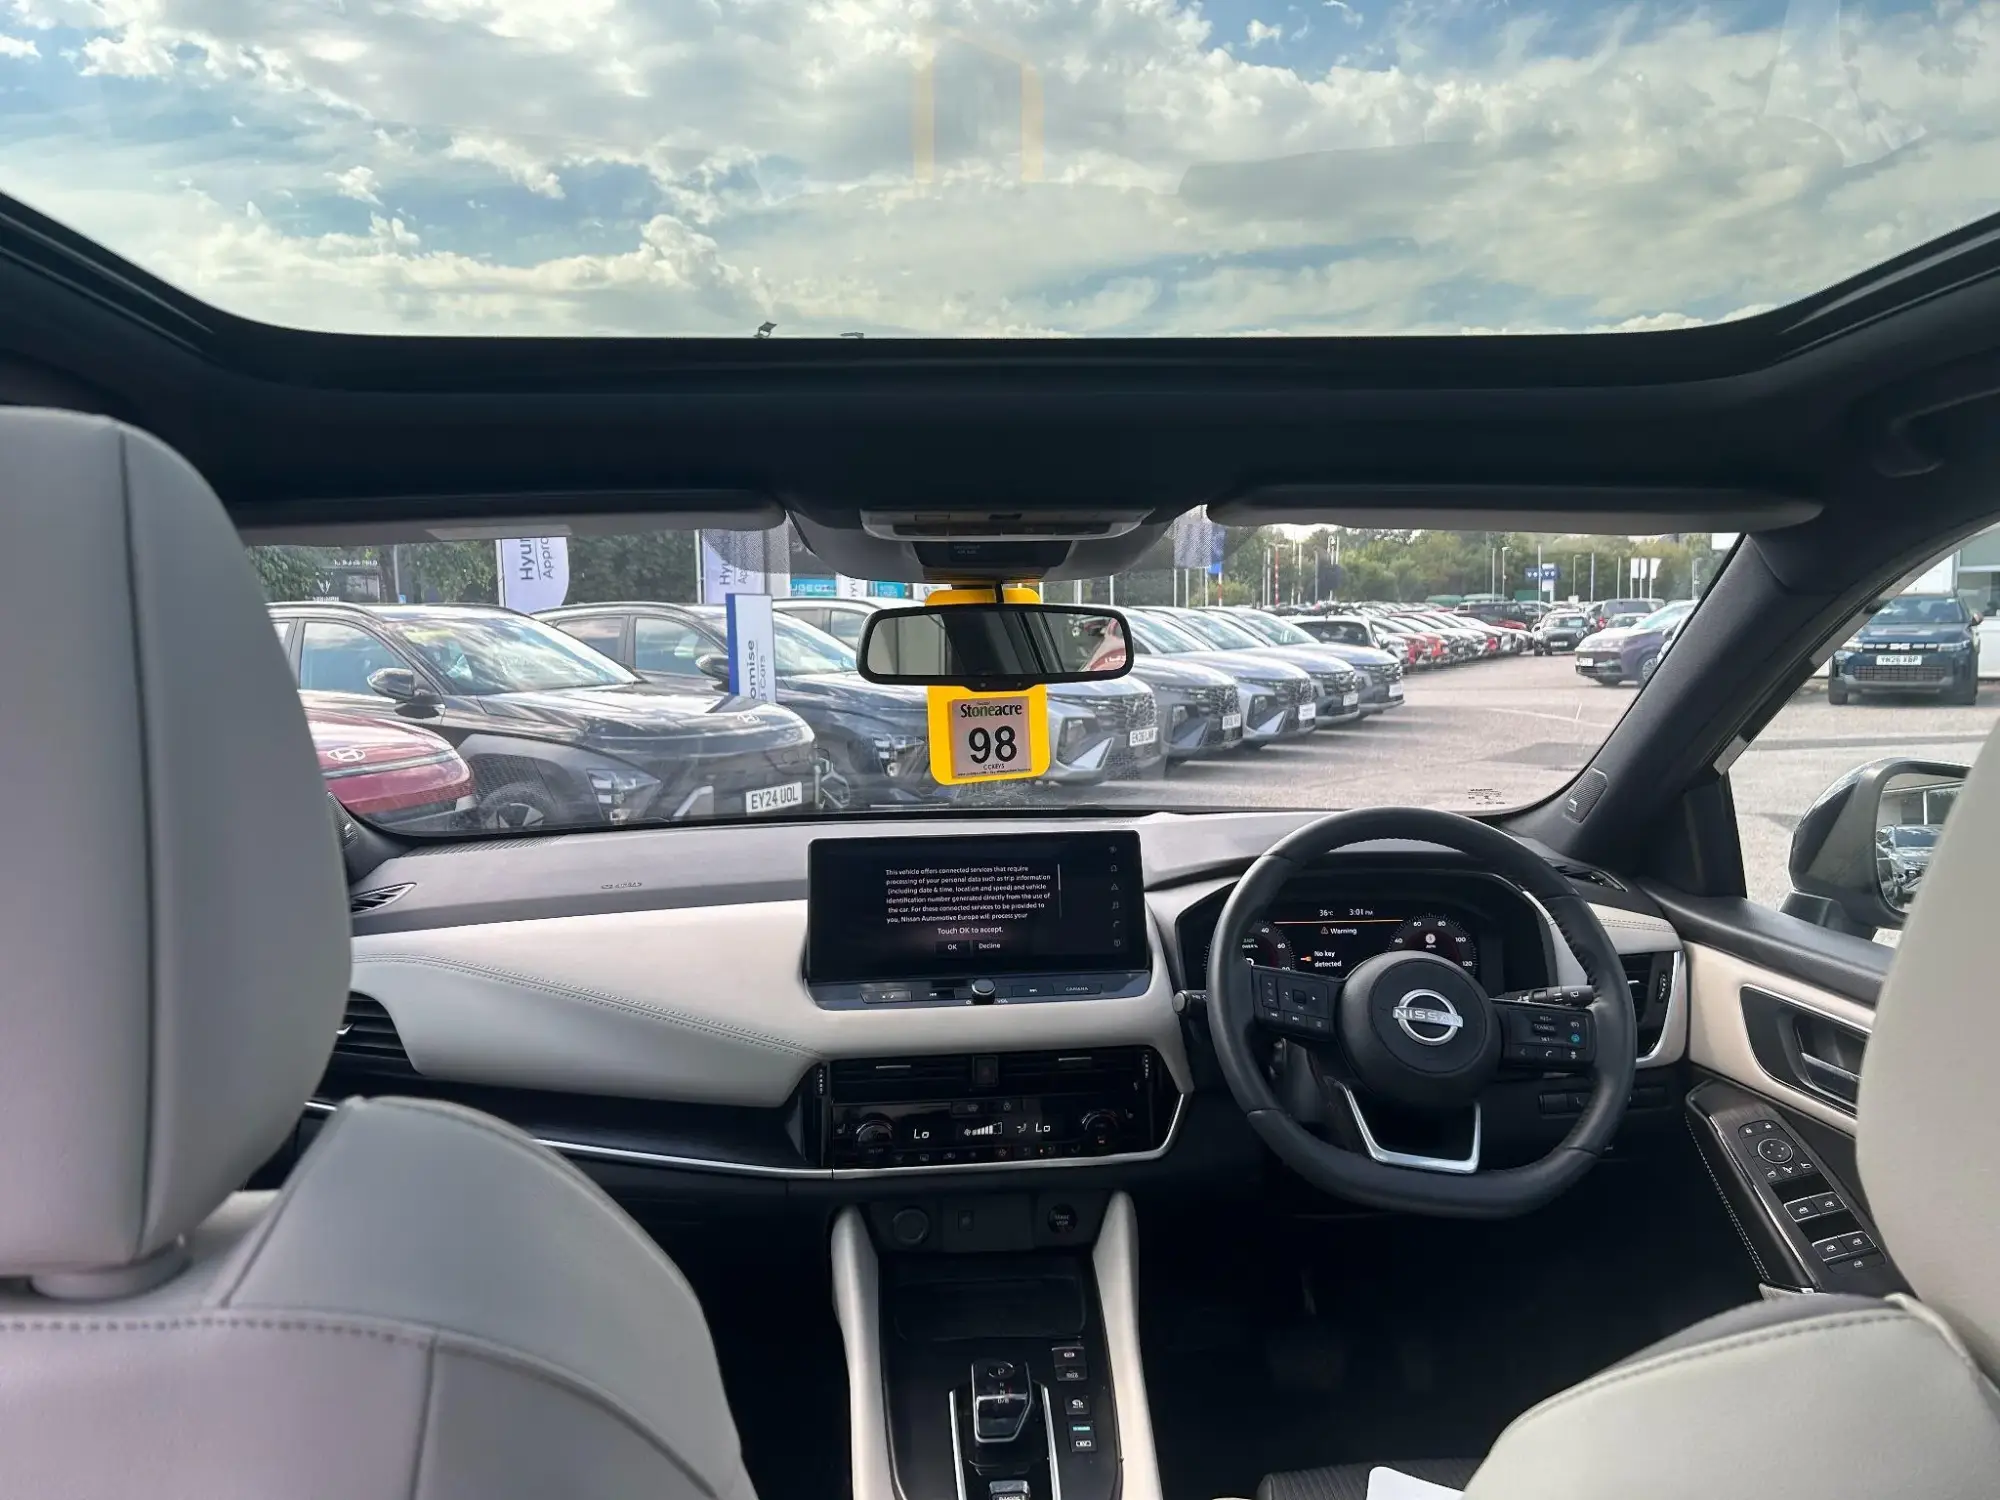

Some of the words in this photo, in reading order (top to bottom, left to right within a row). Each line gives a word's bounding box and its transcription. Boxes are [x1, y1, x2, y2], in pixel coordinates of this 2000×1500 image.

[960, 703, 1022, 718] Stoneacre
[968, 726, 1017, 764] 98
[752, 790, 777, 810] EY24
[1394, 1009, 1462, 1027] NISSAN
[914, 1128, 930, 1139] Lo
[1035, 1122, 1051, 1132] Lo
